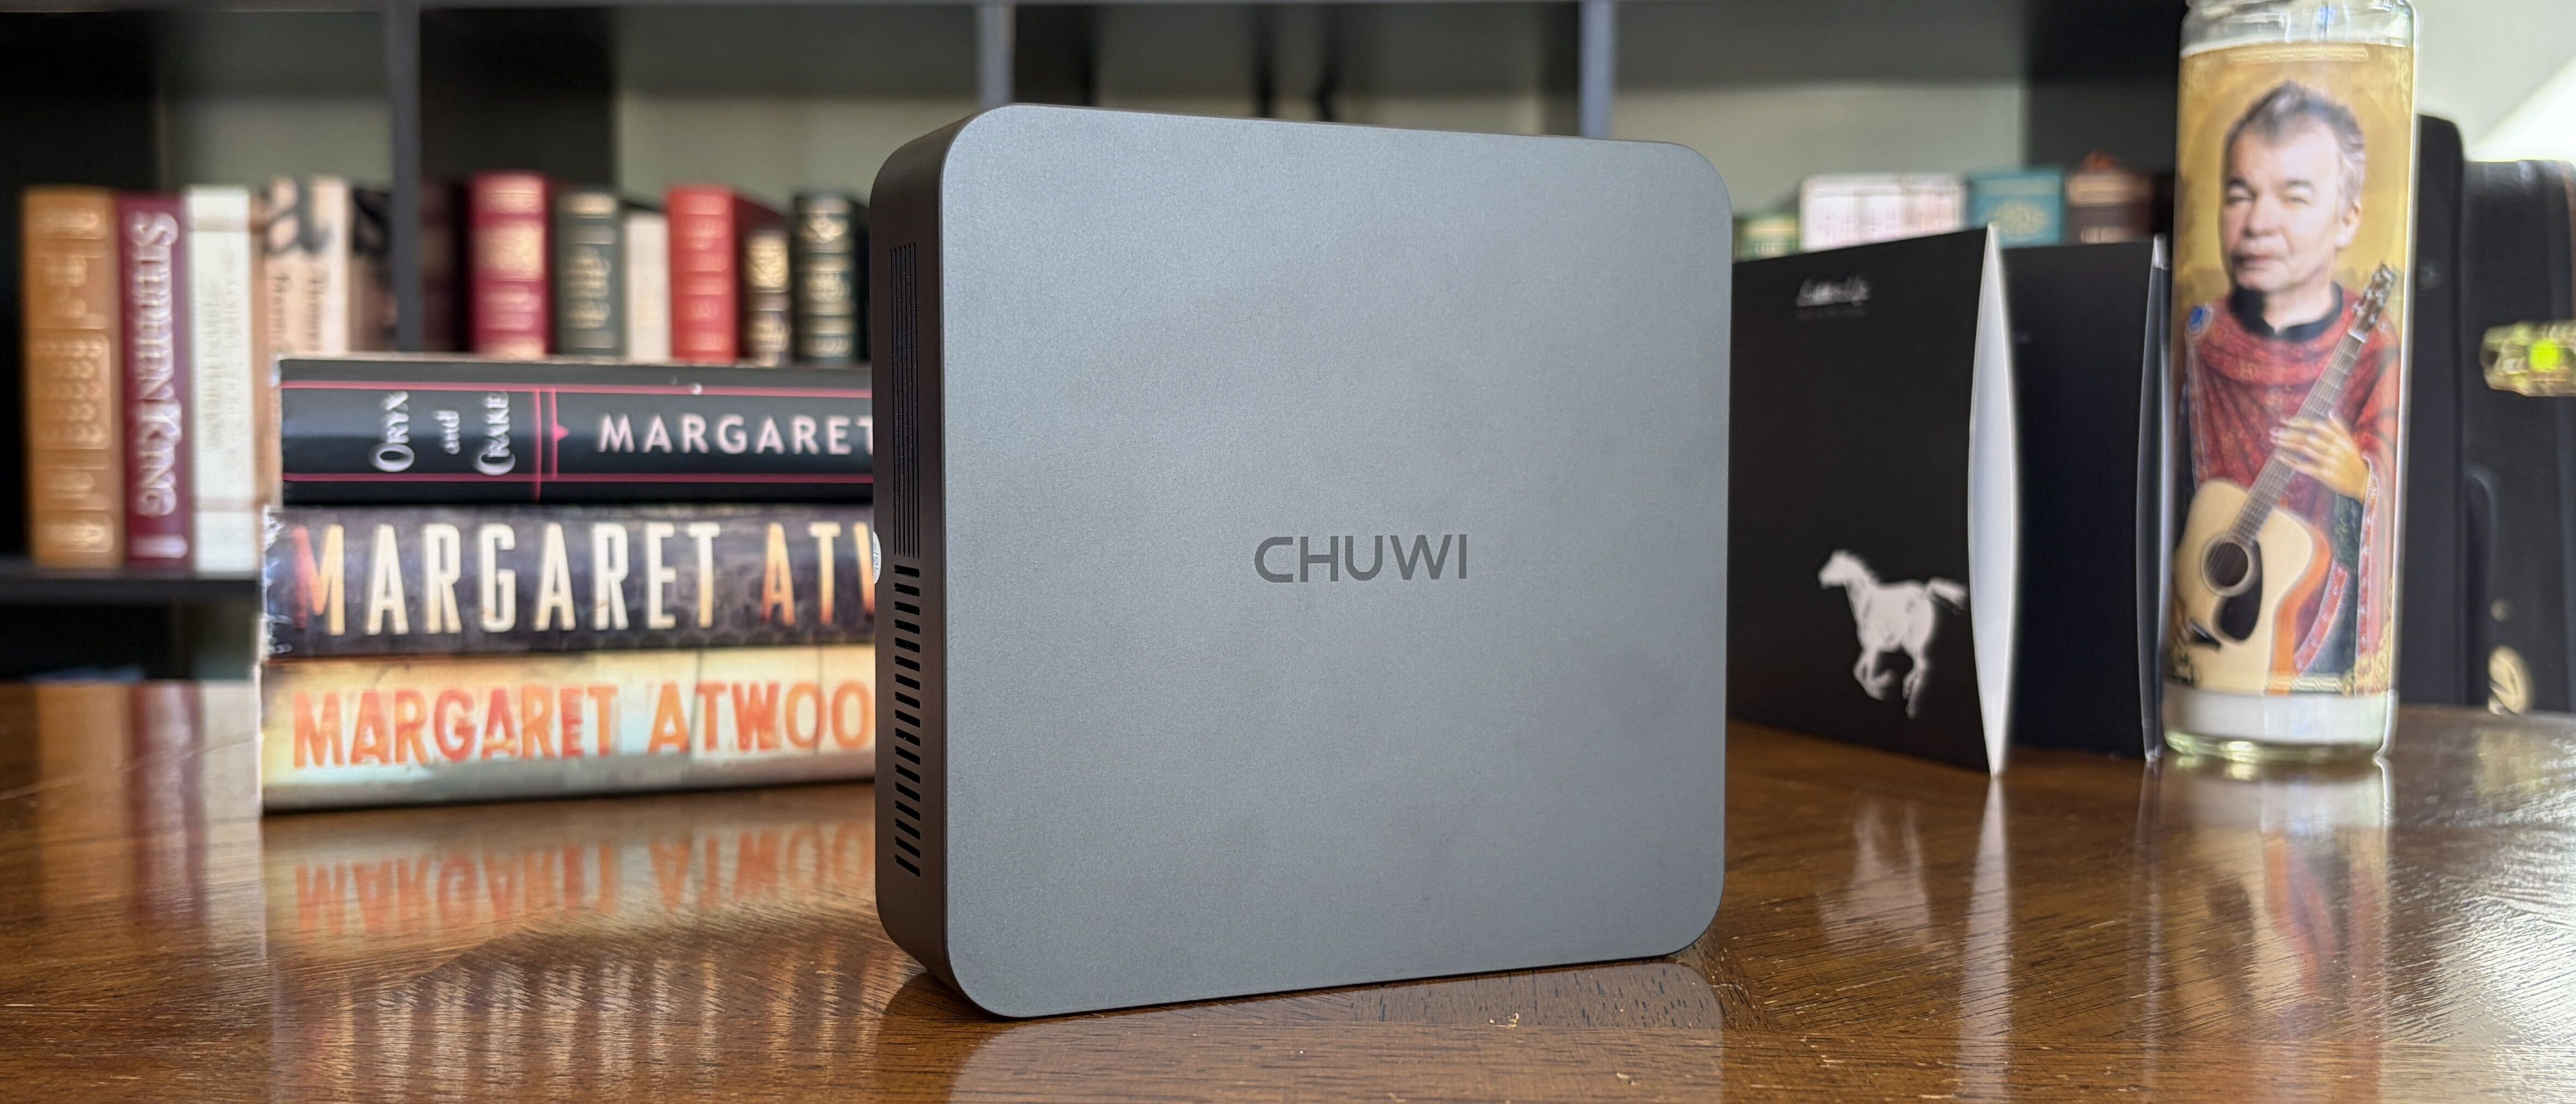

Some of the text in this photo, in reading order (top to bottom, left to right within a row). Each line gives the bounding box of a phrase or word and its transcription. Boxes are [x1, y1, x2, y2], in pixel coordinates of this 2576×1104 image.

[434, 409, 460, 454] and
[291, 522, 721, 636] MARGARET
[1254, 534, 1467, 583] CHUWI
[293, 684, 620, 769] MARGARET
